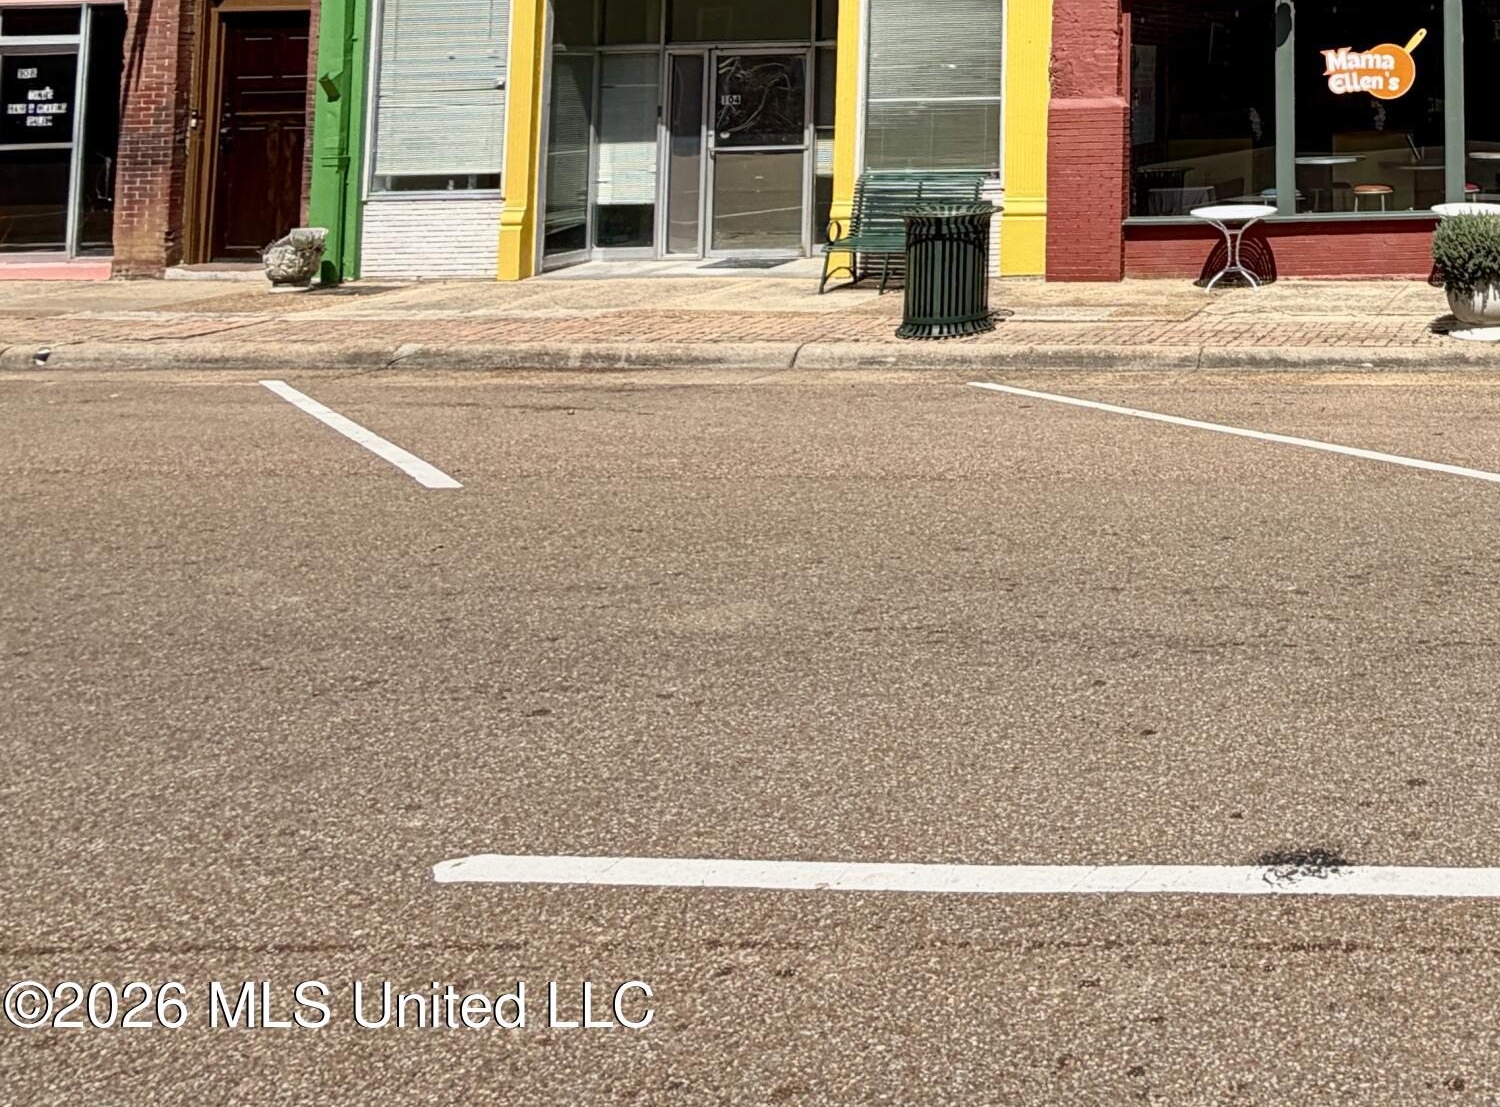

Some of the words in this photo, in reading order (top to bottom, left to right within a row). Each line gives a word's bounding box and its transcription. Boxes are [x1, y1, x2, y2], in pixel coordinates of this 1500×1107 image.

[1320, 47, 1395, 75] Mama
[1328, 71, 1400, 94] Ellen's
[722, 95, 741, 105] 104
